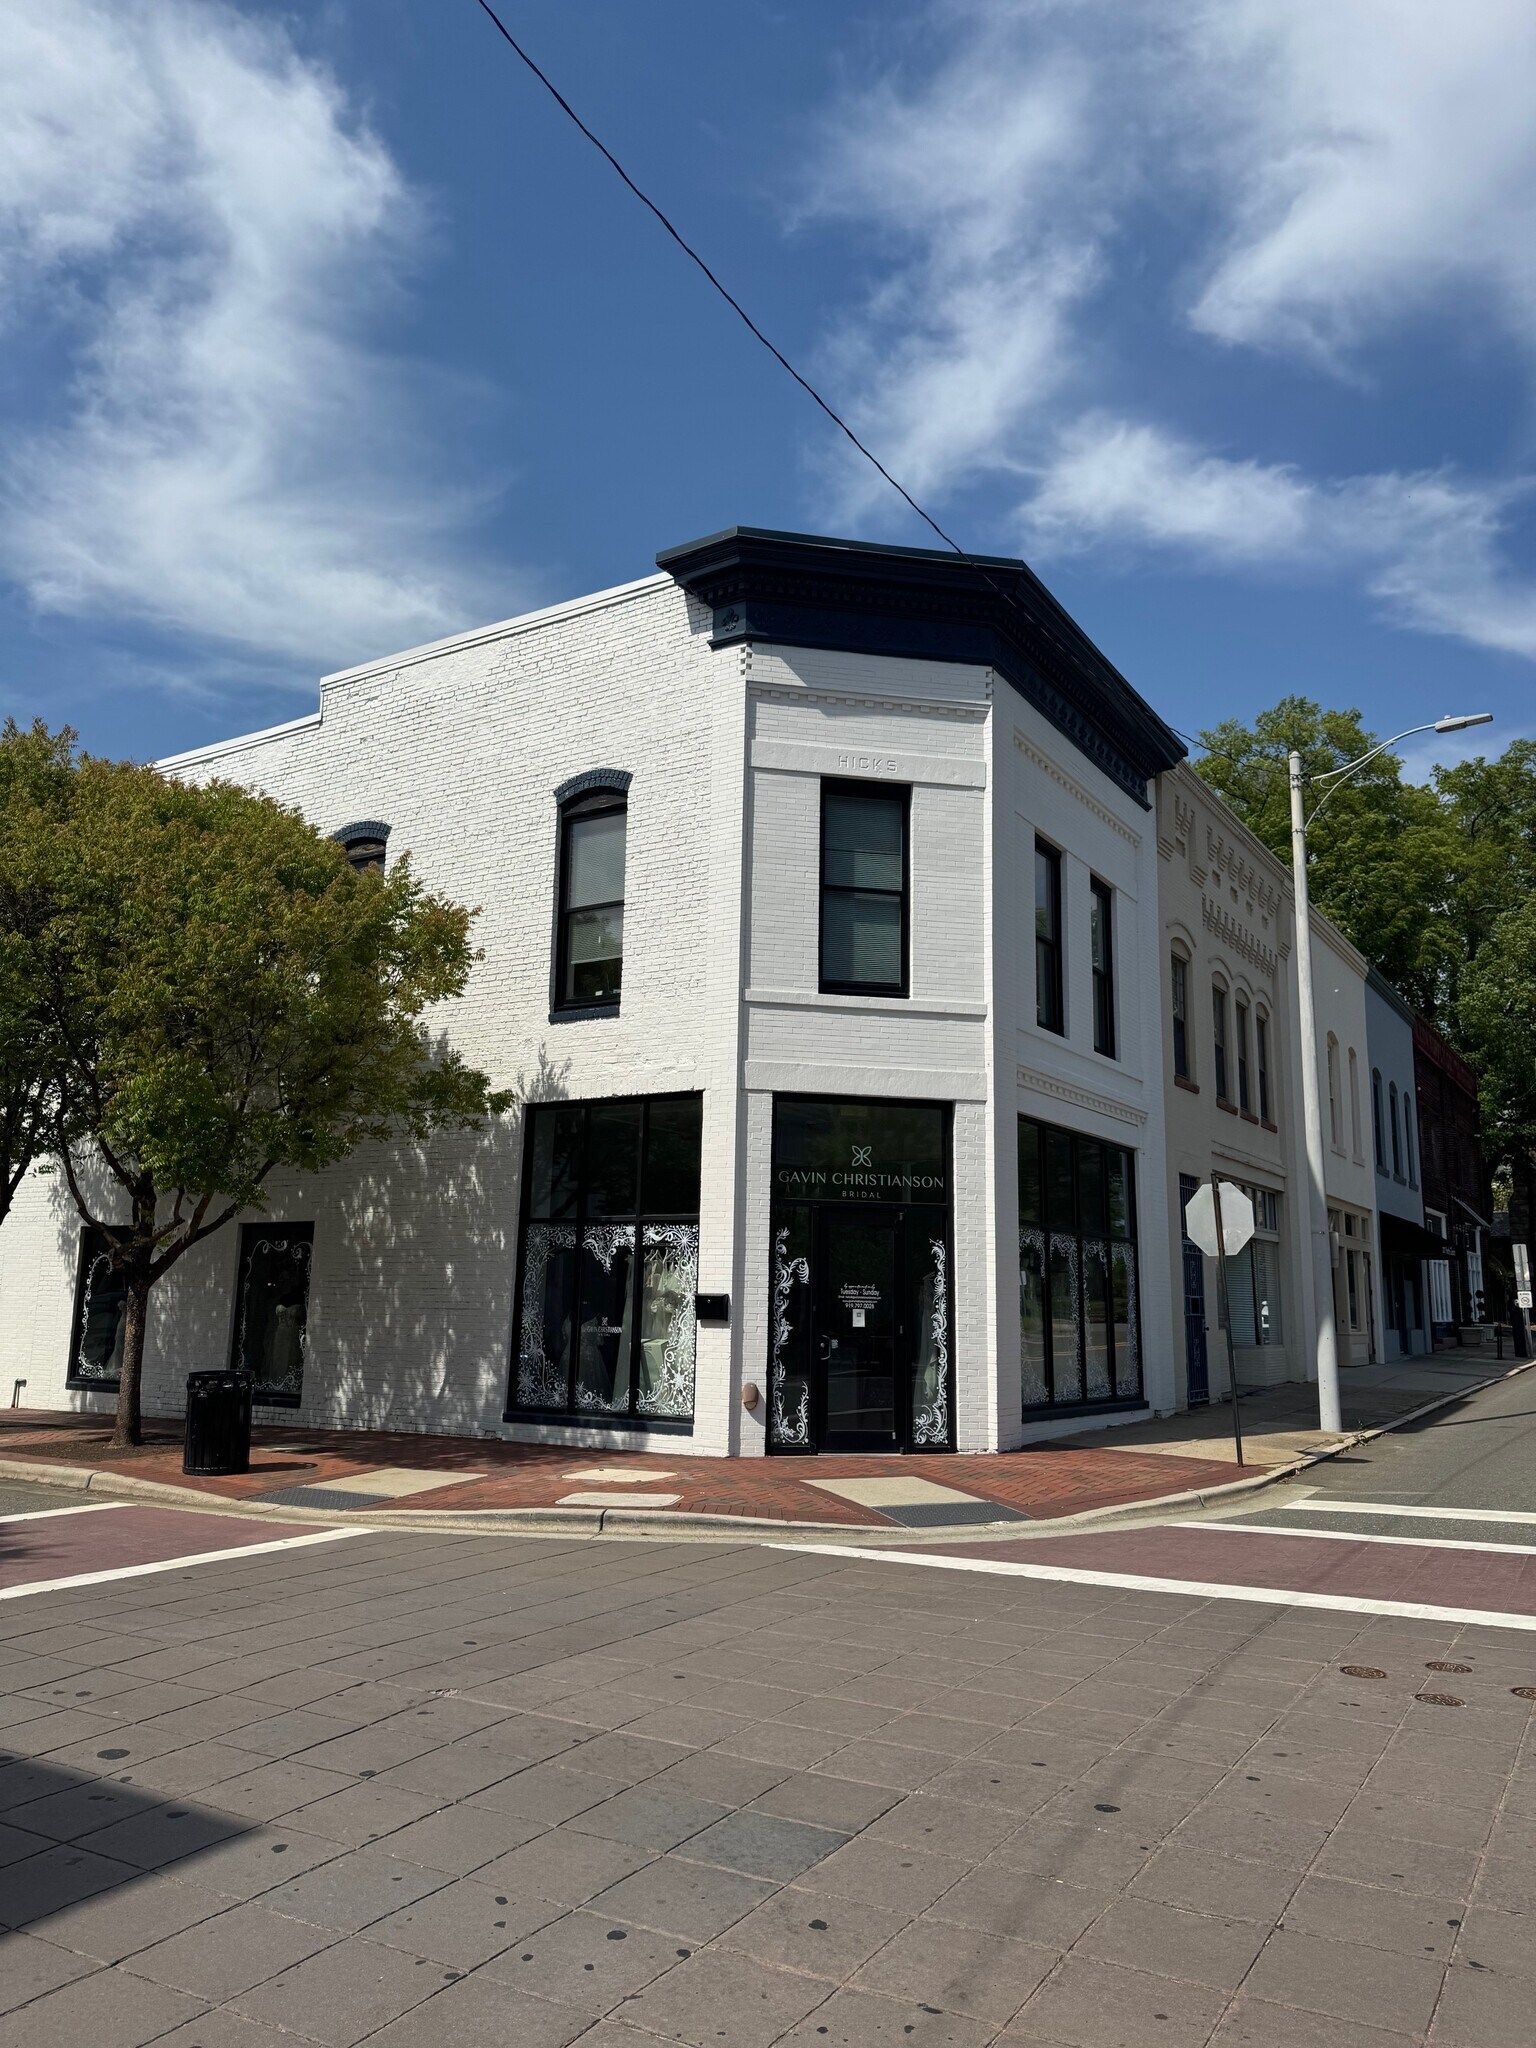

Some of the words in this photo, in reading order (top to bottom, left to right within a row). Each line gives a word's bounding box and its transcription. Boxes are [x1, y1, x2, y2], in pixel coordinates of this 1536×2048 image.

[838, 755, 897, 773] HICKS
[778, 1170, 827, 1184] GAVIN
[832, 1172, 944, 1188] CHRISTIANSON
[842, 1190, 881, 1199] BRIDAL
[840, 1288, 859, 1296] Tuesday
[862, 1289, 880, 1297] Sunday
